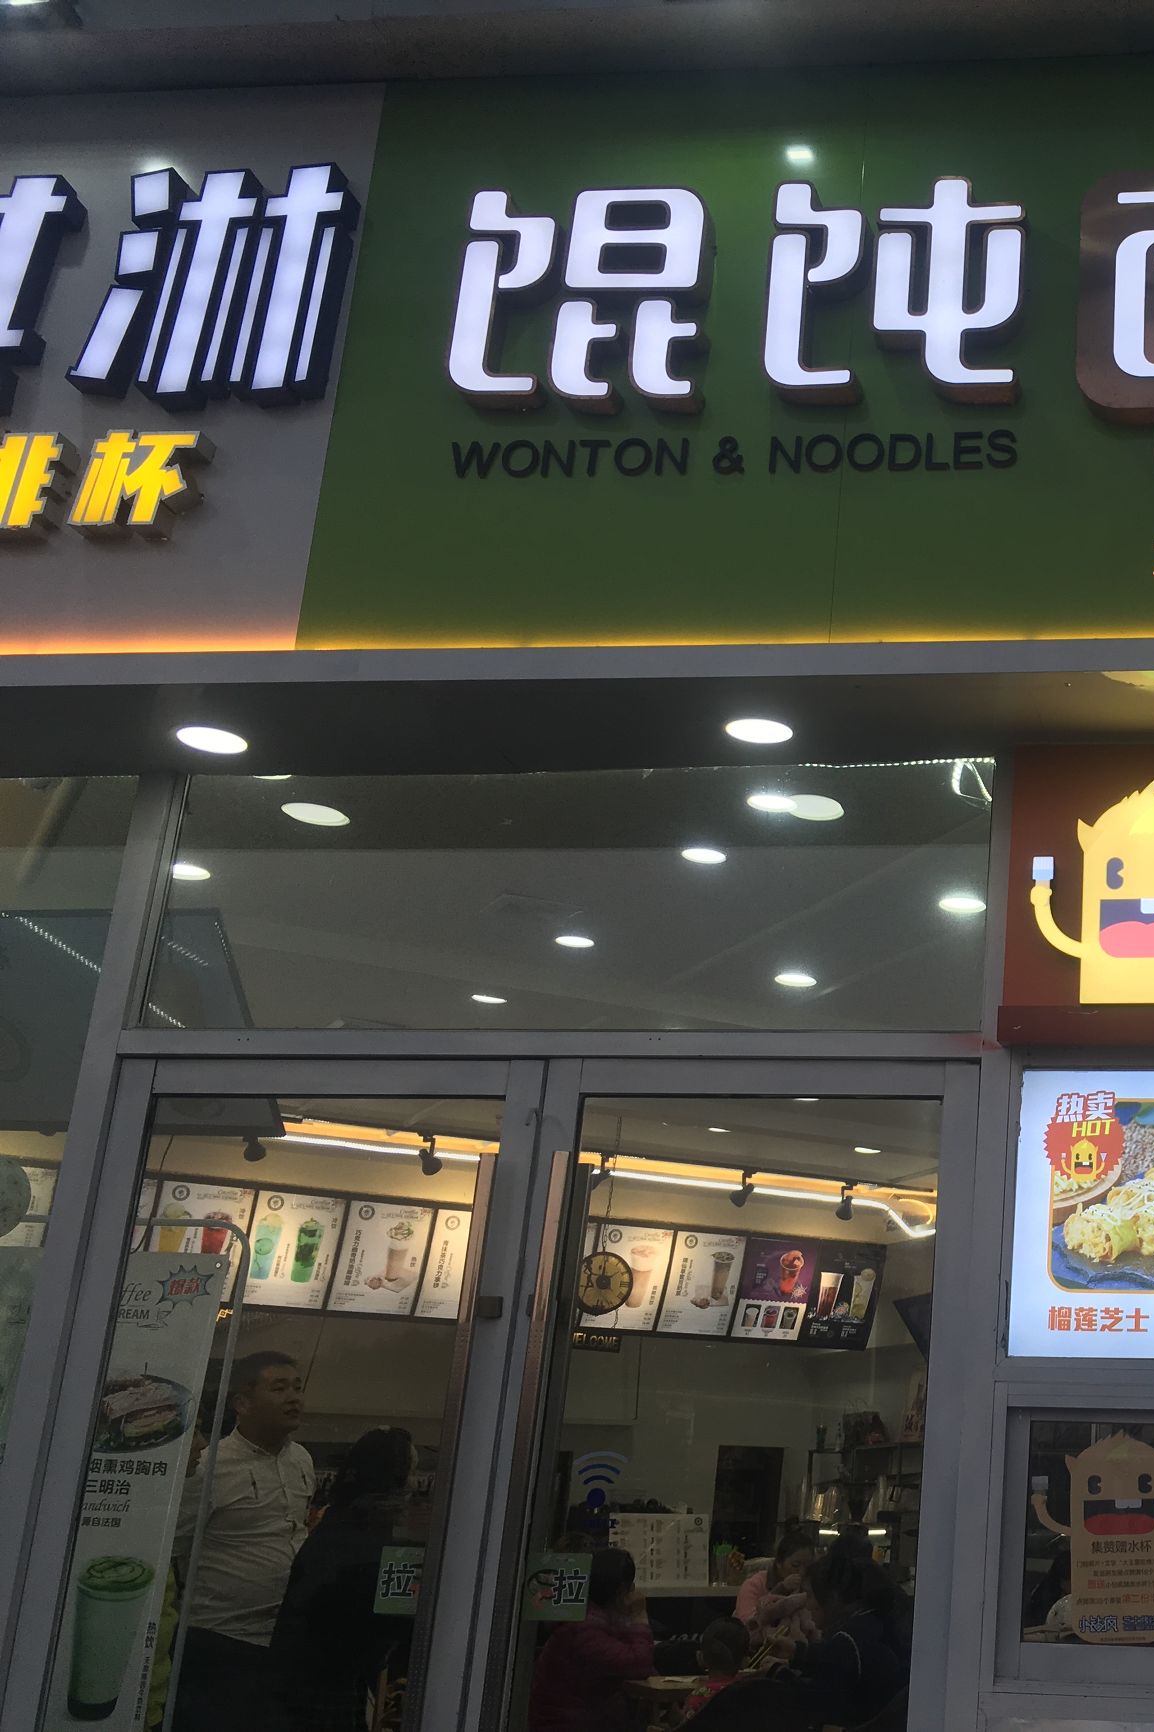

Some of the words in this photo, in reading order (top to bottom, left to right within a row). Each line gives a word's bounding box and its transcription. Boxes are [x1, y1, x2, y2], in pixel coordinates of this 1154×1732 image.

[452, 440, 689, 478] WONTON
[714, 436, 744, 474] &
[769, 430, 1018, 474] NOODLES
[1055, 1091, 1117, 1122] 热卖
[1072, 1119, 1115, 1138] HOT
[1047, 1305, 1150, 1333] 榴莲芝士
[85, 1479, 132, 1496] 三明治
[381, 1562, 415, 1599] 拉
[552, 1568, 587, 1606] 拉
